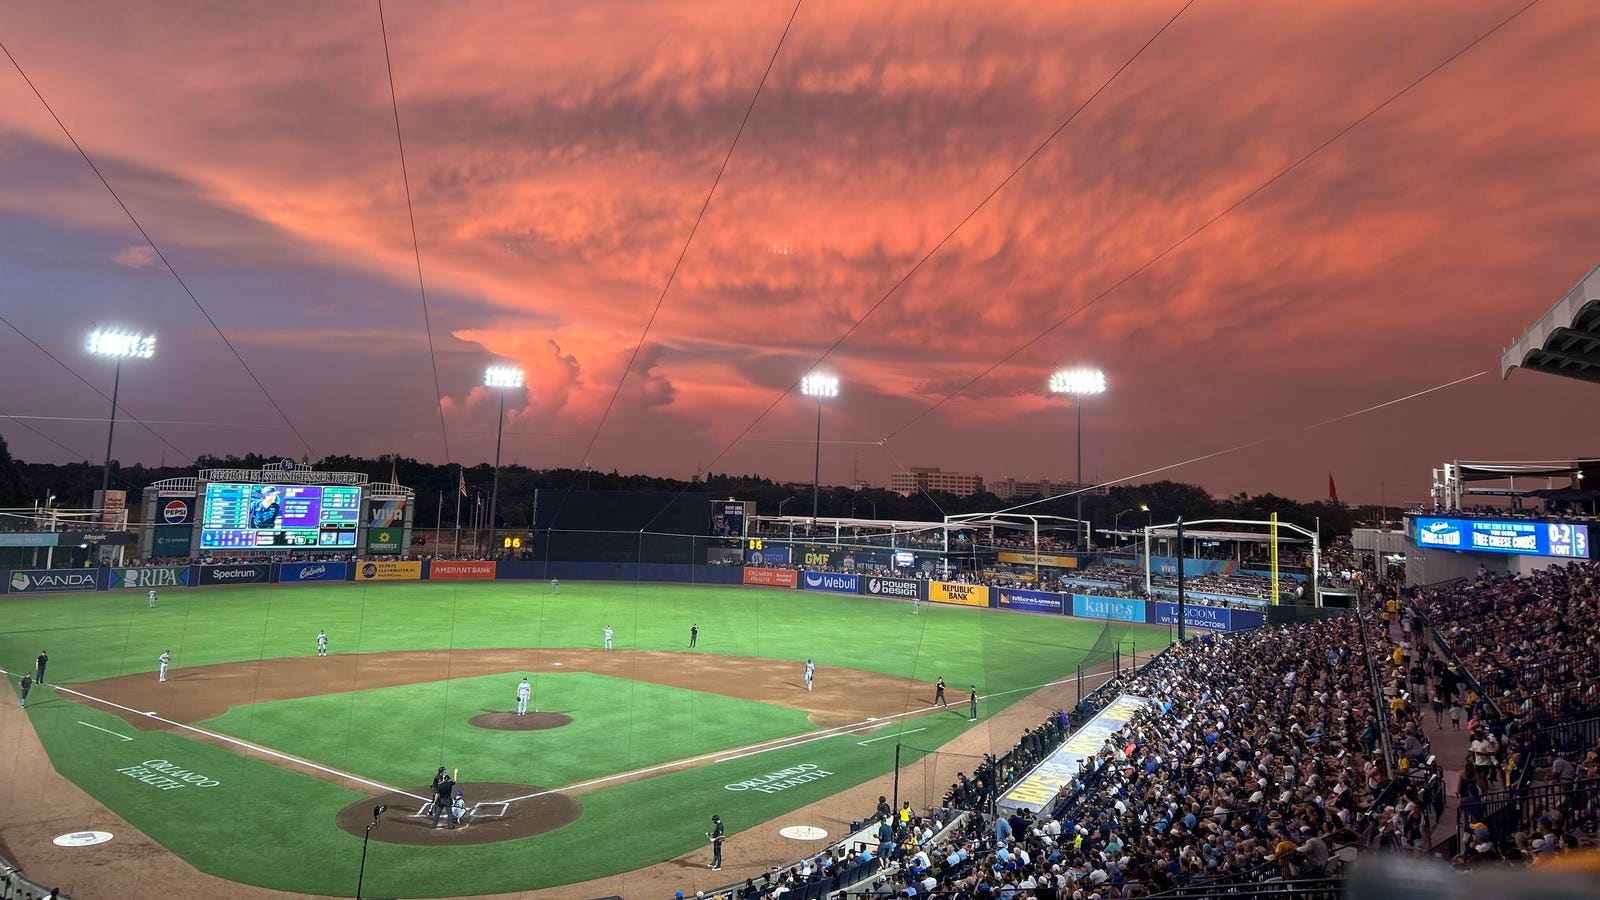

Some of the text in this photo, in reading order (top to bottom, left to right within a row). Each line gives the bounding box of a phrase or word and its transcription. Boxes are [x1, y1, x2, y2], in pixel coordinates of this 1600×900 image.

[211, 470, 250, 480] GEORGE
[263, 470, 331, 482] STEINBRENNER
[332, 473, 359, 482] FIELD
[373, 508, 403, 521] VIVA
[1473, 532, 1489, 546] FREE
[1489, 535, 1512, 548] CHEESE
[1549, 524, 1571, 543] 0-2
[1576, 533, 1586, 549] 3
[805, 553, 829, 565] GMF
[139, 568, 177, 587] RIPA
[213, 569, 255, 580] Spectrum
[299, 565, 327, 579] Culver's
[32, 575, 95, 586] VANDA
[824, 577, 856, 589] Webull
[942, 584, 975, 594] REPUBLIC
[948, 592, 968, 601] BANK
[1085, 597, 1134, 616] kane's
[1194, 619, 1226, 630] DOCTORS
[115, 765, 186, 791] HEALTH
[142, 759, 220, 788] ORLANDO
[724, 763, 818, 791] ORLANDO
[751, 769, 835, 794] HEALTH
